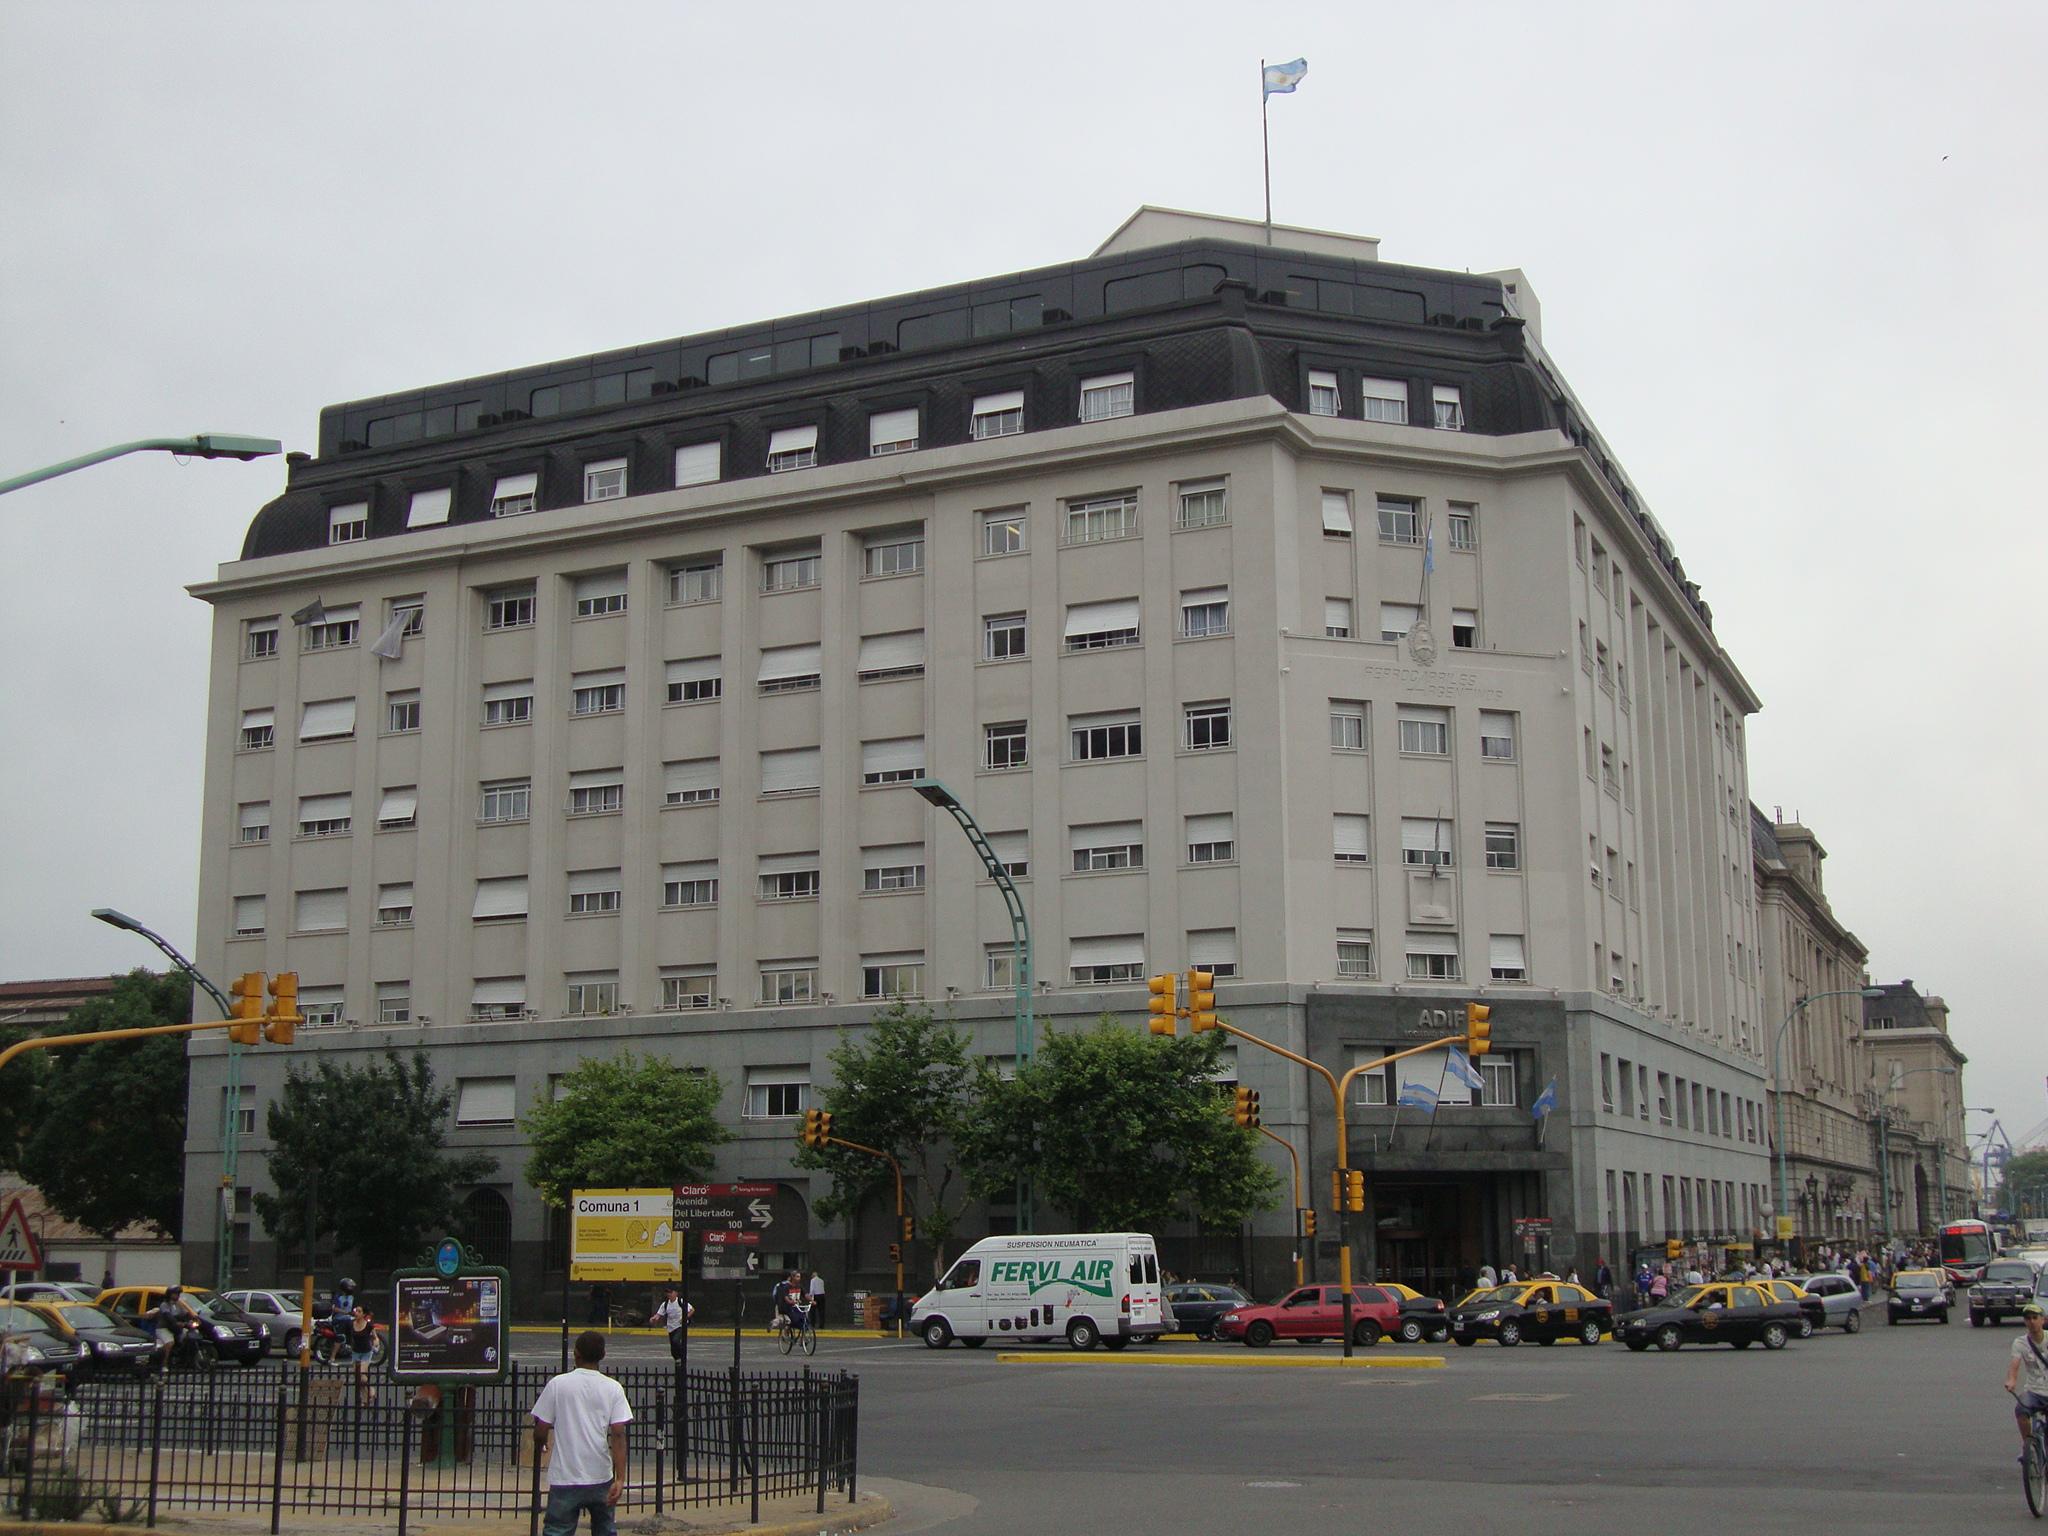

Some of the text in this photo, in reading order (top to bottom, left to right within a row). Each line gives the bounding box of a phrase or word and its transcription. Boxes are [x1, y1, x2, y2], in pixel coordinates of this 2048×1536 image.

[1418, 1009, 1466, 1028] ADIF
[682, 1186, 708, 1195] Claro
[675, 1197, 708, 1206] Avenida
[579, 1200, 640, 1213] Comuna 1
[674, 1209, 735, 1218] Del Libertador
[674, 1220, 743, 1229] 200 100
[709, 1233, 725, 1242] Claro
[1054, 1240, 1097, 1248] NEUMATICA
[704, 1245, 724, 1253] Avenida
[991, 1259, 1114, 1282] FERVI AIR
